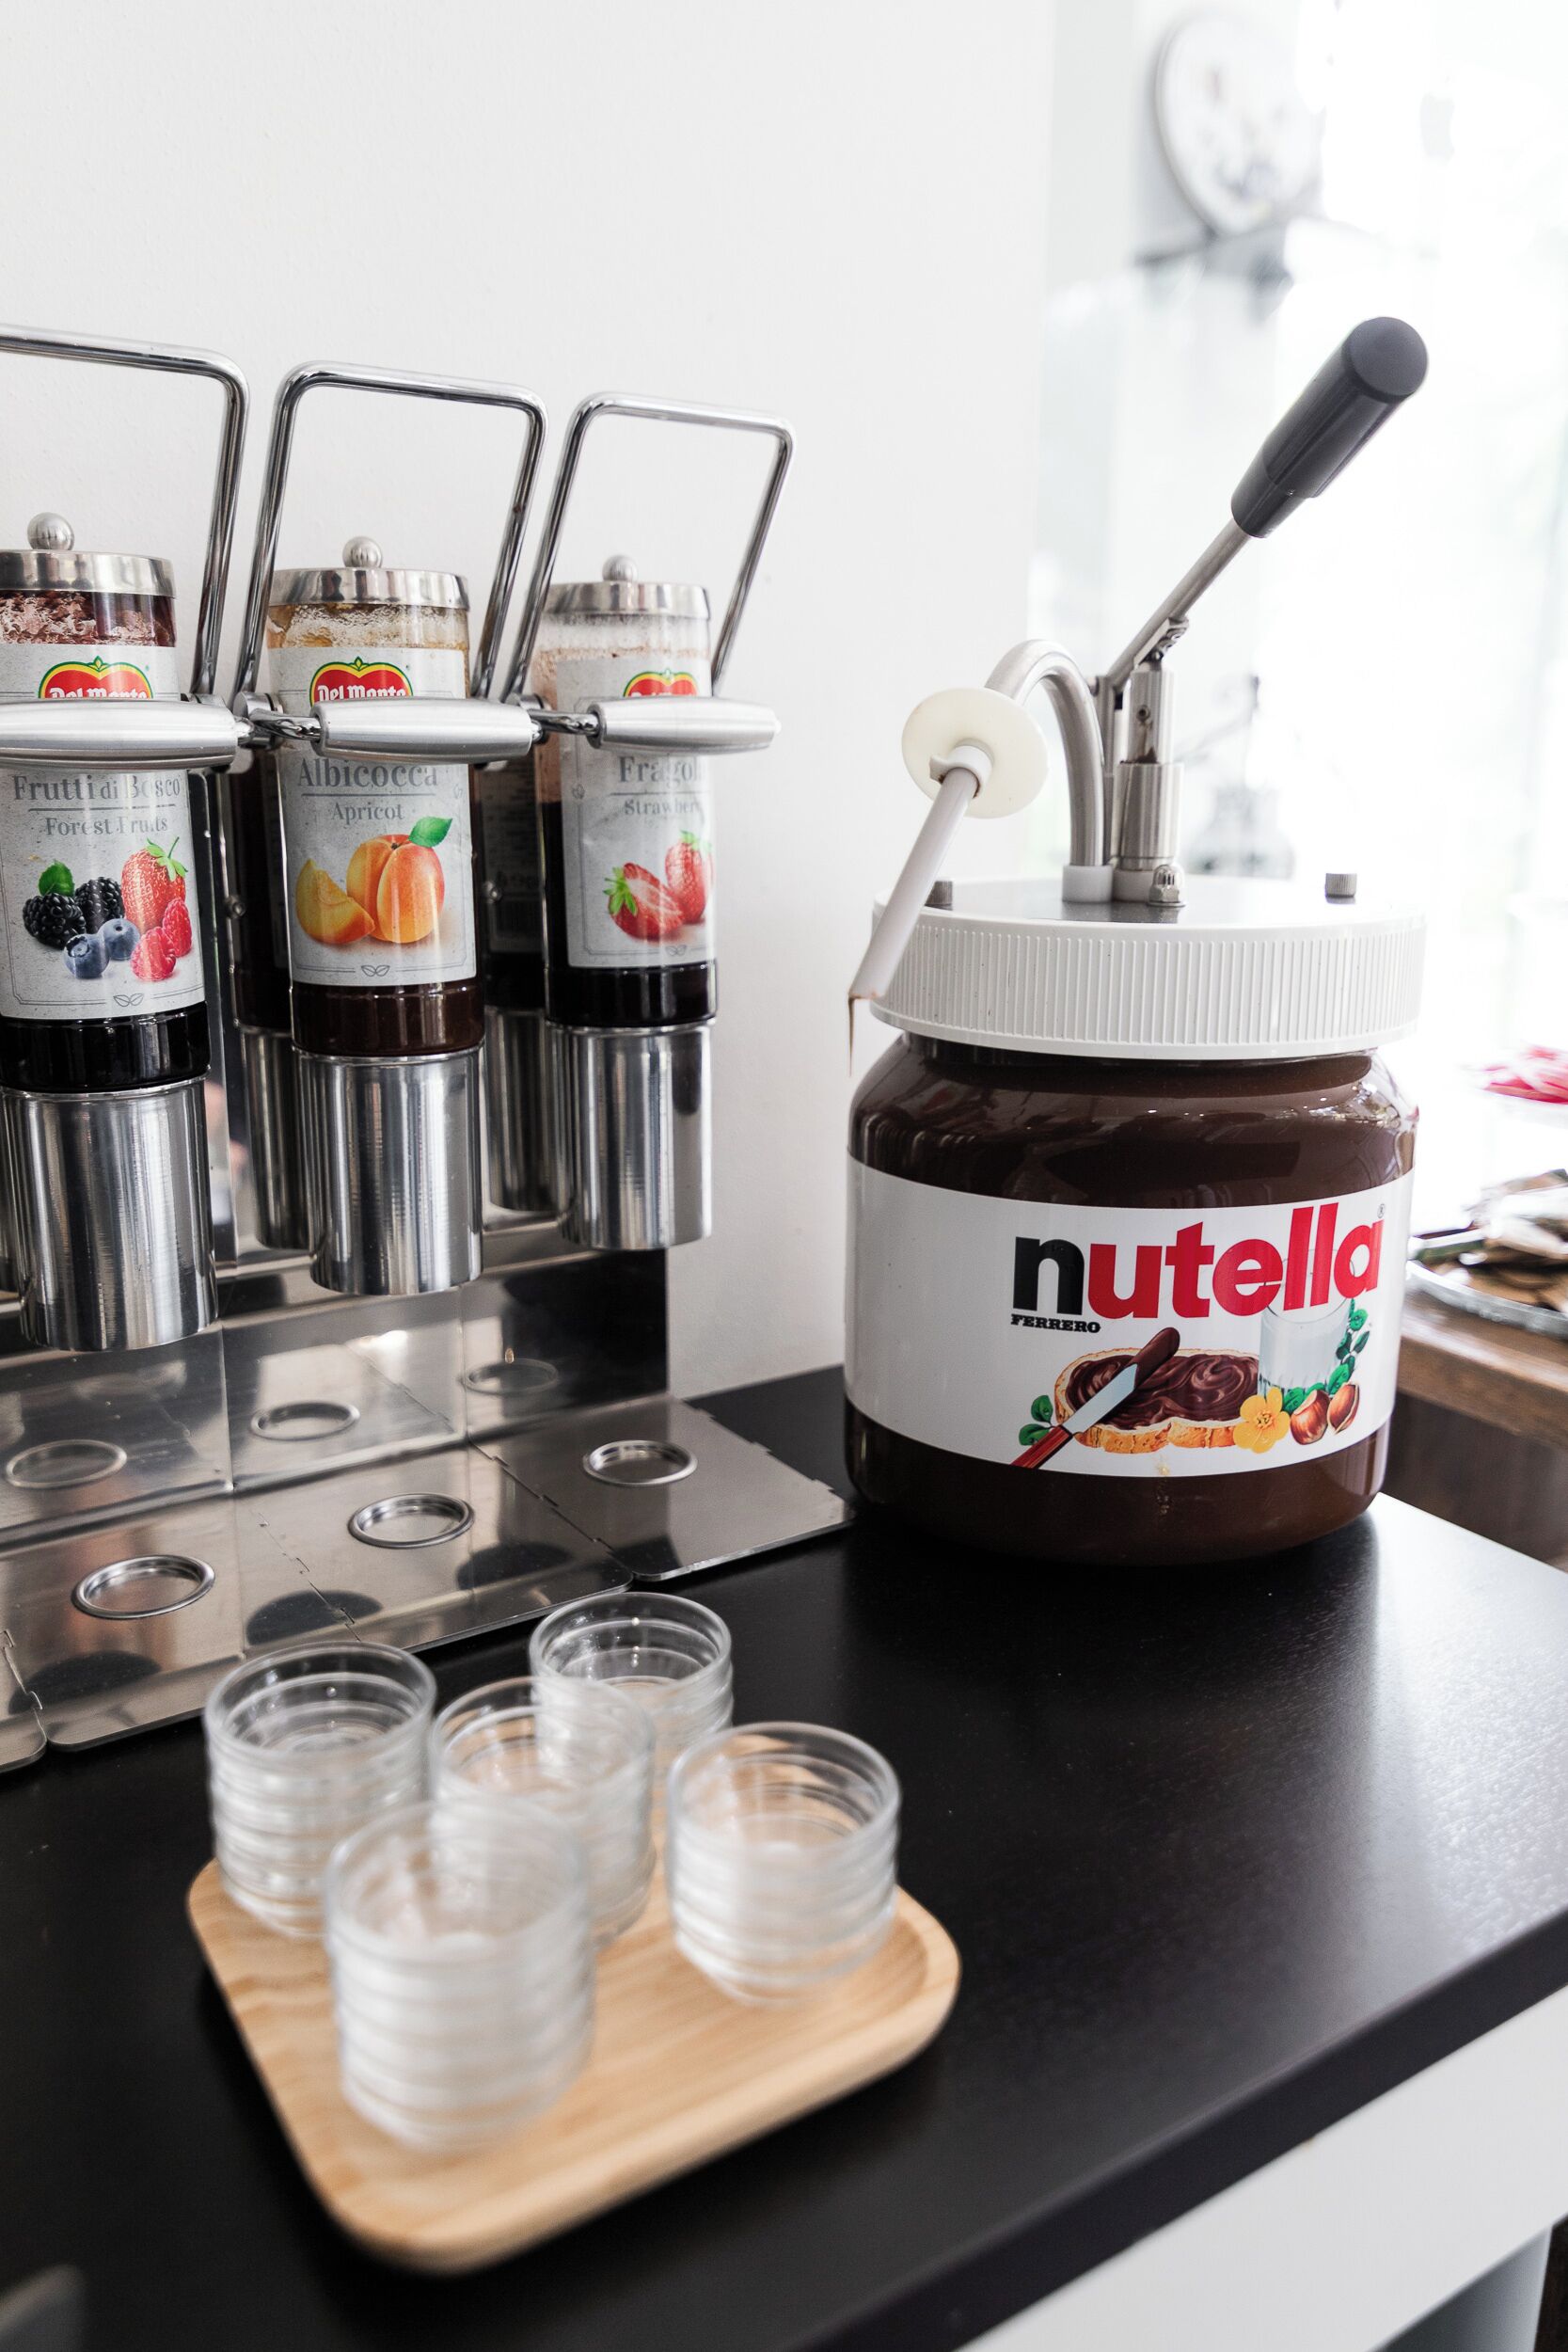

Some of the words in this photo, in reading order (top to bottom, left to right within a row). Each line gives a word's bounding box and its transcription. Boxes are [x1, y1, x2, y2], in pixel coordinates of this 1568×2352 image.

[317, 684, 344, 702] Del
[346, 684, 406, 699] Monte
[296, 757, 438, 788] Albicocca
[617, 755, 705, 788] Fragol
[13, 774, 97, 800] Frutti
[100, 779, 119, 799] di
[331, 802, 405, 825] Apricot
[45, 817, 113, 835] Forest
[1012, 1202, 1384, 1319] nutella
[1010, 1312, 1101, 1334] FERRERO
